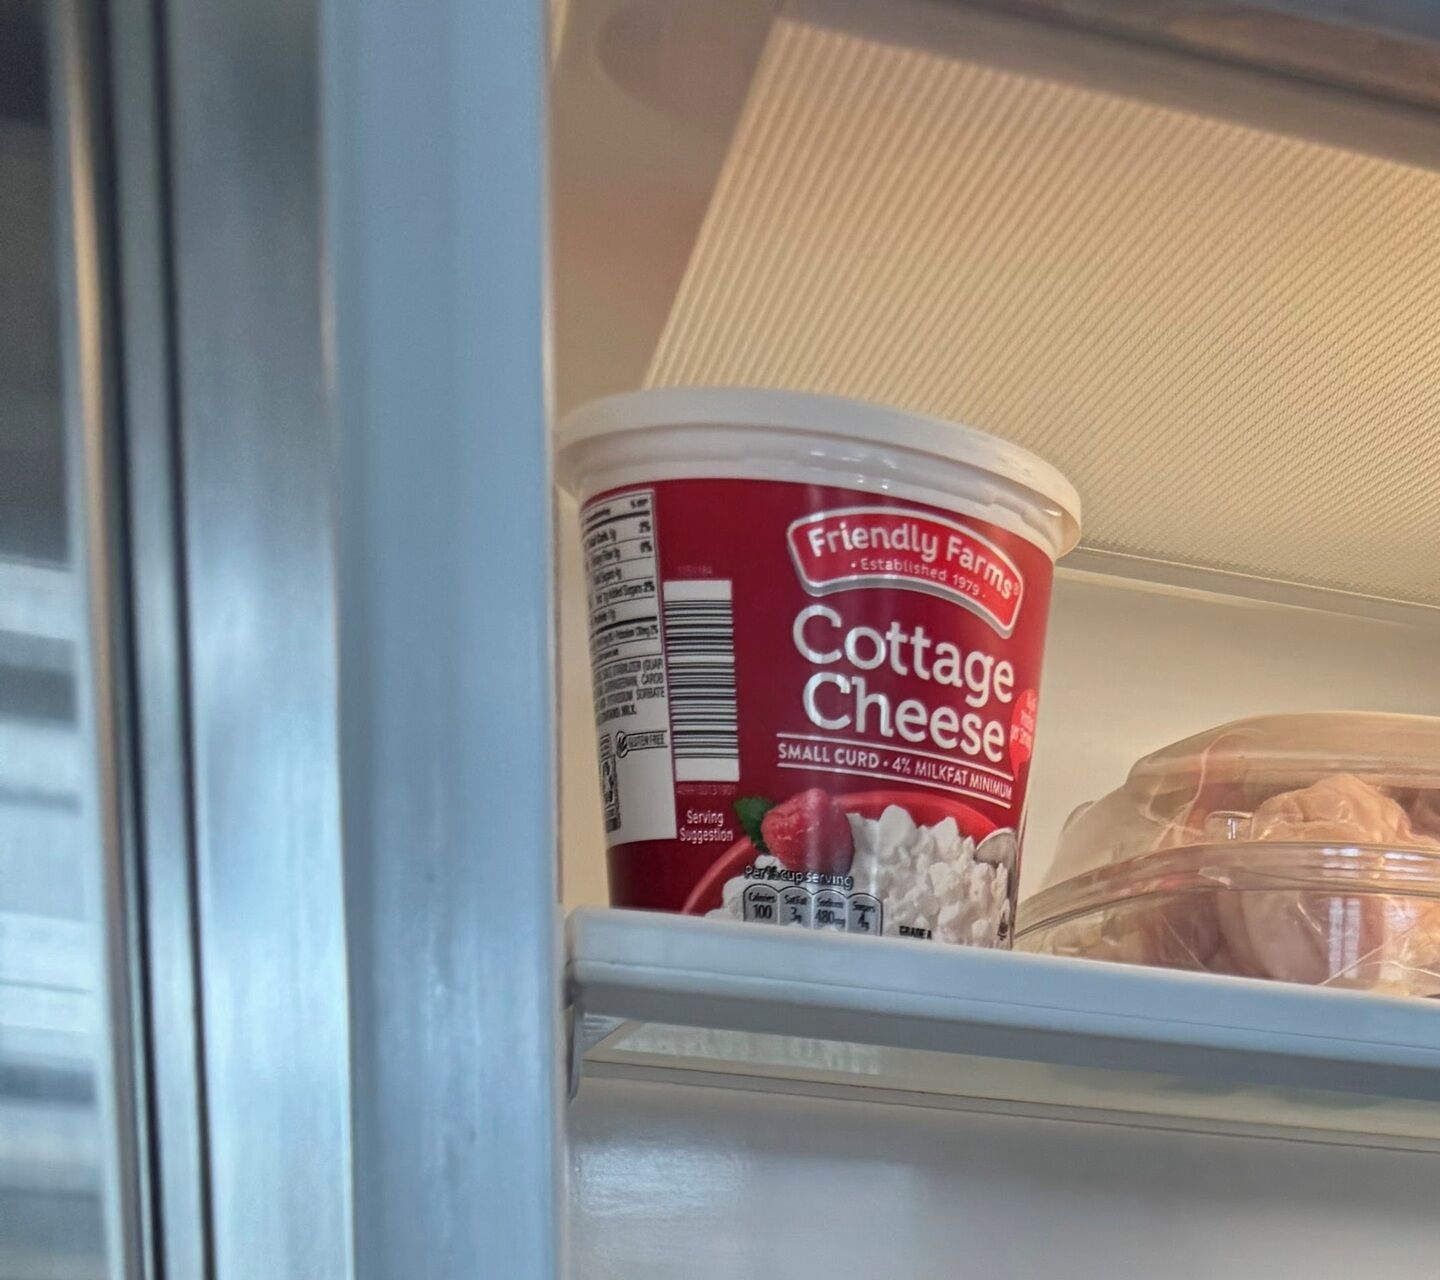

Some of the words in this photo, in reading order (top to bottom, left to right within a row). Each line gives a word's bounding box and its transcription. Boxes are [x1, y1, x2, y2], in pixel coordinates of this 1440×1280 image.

[807, 521, 938, 562] Friendly
[861, 557, 947, 581] Established
[952, 573, 981, 597] 1979
[793, 604, 1014, 708] Cottage
[803, 672, 1005, 763] Cheese
[778, 743, 830, 764] SMALL
[834, 748, 880, 769] CURD
[891, 757, 911, 775] 4%
[914, 761, 969, 784] MILKFAT
[969, 773, 1013, 801] MINIMUM
[679, 827, 734, 845] Suggestion
[686, 809, 724, 827] Serving
[780, 868, 804, 887] cup
[805, 871, 854, 891] serving
[753, 903, 773, 920] 100
